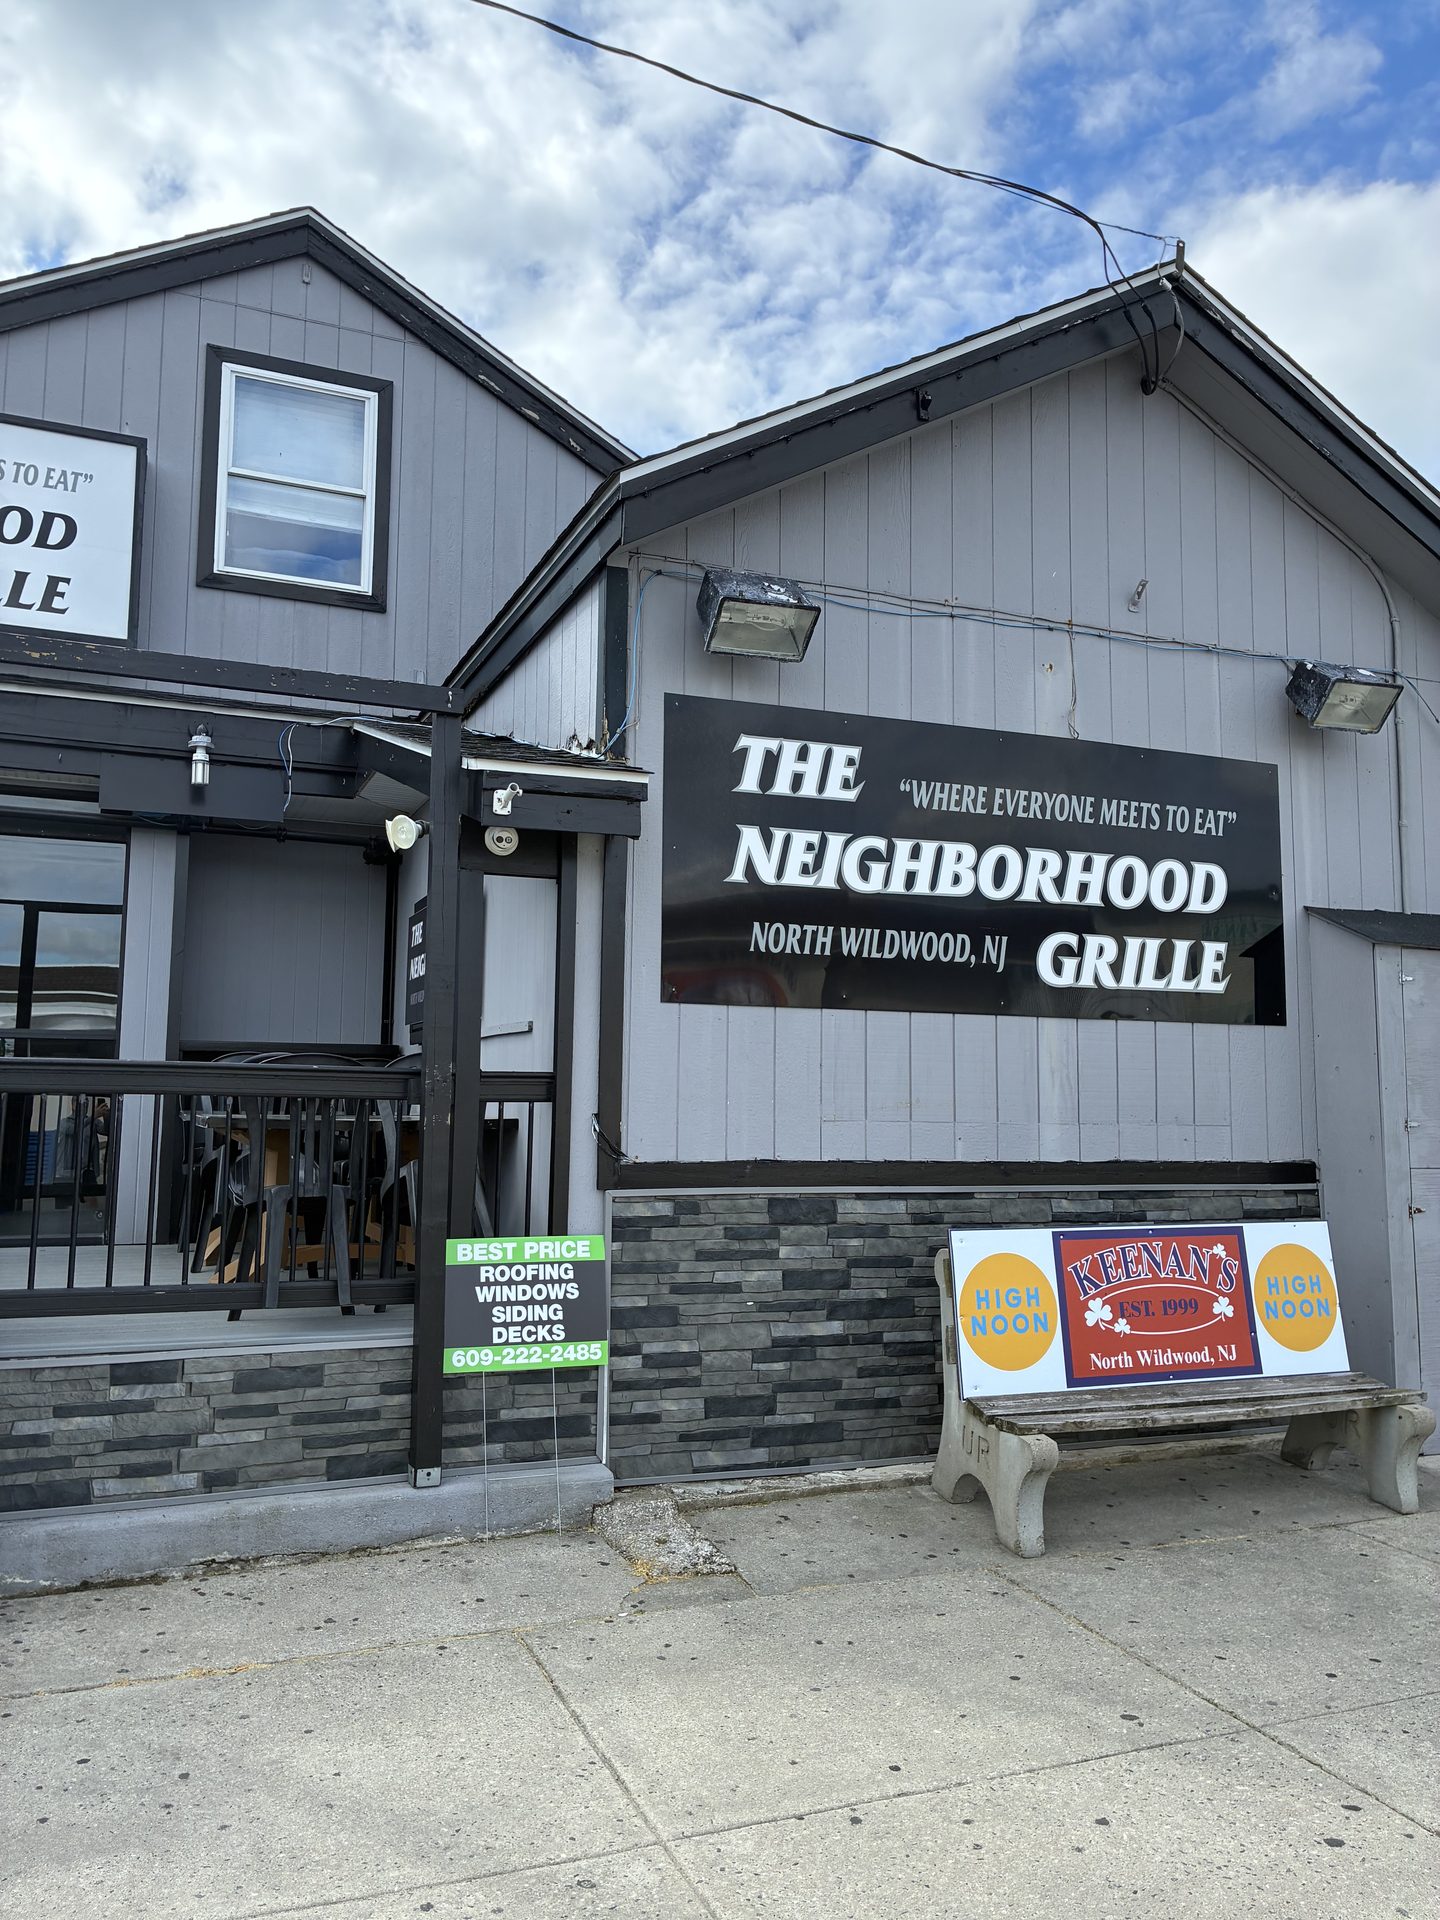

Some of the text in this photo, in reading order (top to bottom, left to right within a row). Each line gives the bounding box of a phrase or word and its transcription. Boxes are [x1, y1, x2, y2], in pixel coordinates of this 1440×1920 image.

[12, 461, 39, 486] TO
[0, 570, 72, 615] LE
[732, 733, 865, 802] THE
[900, 778, 1237, 837] “WHERE EVERYONE MEETS TO EAT”
[723, 824, 1228, 915] NEIGHBORHOOD
[411, 921, 424, 948] THE
[749, 921, 1008, 973] NORTH WILDWOOD, NJ
[409, 953, 426, 981] NEIG
[1036, 931, 1232, 994] GRILLE
[457, 1240, 591, 1262] BEST PRICE
[480, 1263, 574, 1282] ROOFING
[1266, 1274, 1322, 1296] HIGH
[475, 1283, 579, 1303] WINDOWS
[975, 1286, 1041, 1310] HIGH
[491, 1304, 564, 1323] SIDING
[1119, 1298, 1198, 1318] EST. 1999
[1264, 1297, 1332, 1320] NOON
[492, 1324, 566, 1344] DECKS
[971, 1311, 1049, 1337] NOON
[452, 1344, 602, 1367] 609-222-2485
[1090, 1344, 1237, 1371] North Wildwood, NJ
